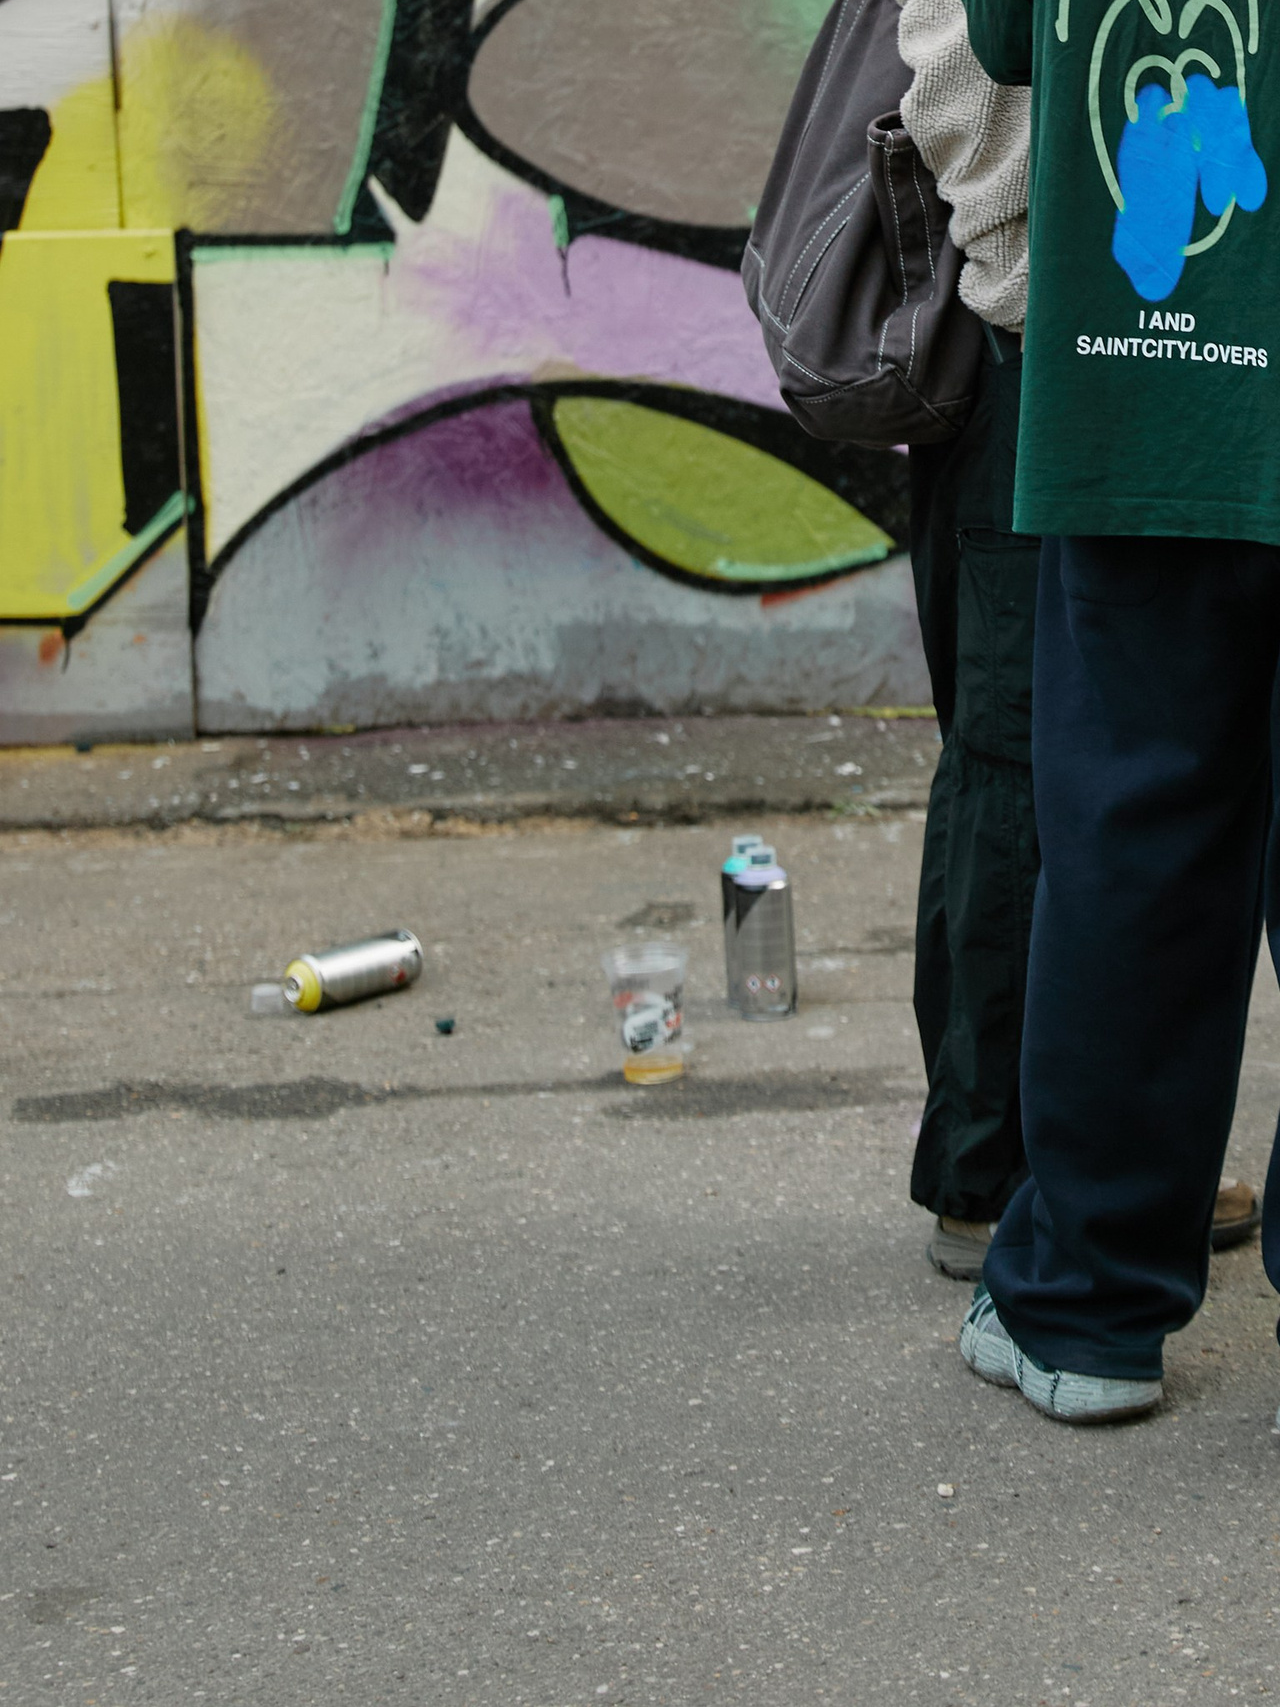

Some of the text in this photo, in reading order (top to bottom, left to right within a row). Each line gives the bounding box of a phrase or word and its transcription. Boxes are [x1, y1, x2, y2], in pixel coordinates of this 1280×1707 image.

[1138, 310, 1196, 332] I AND
[1076, 335, 1268, 368] SAINTCITYLOVERS
